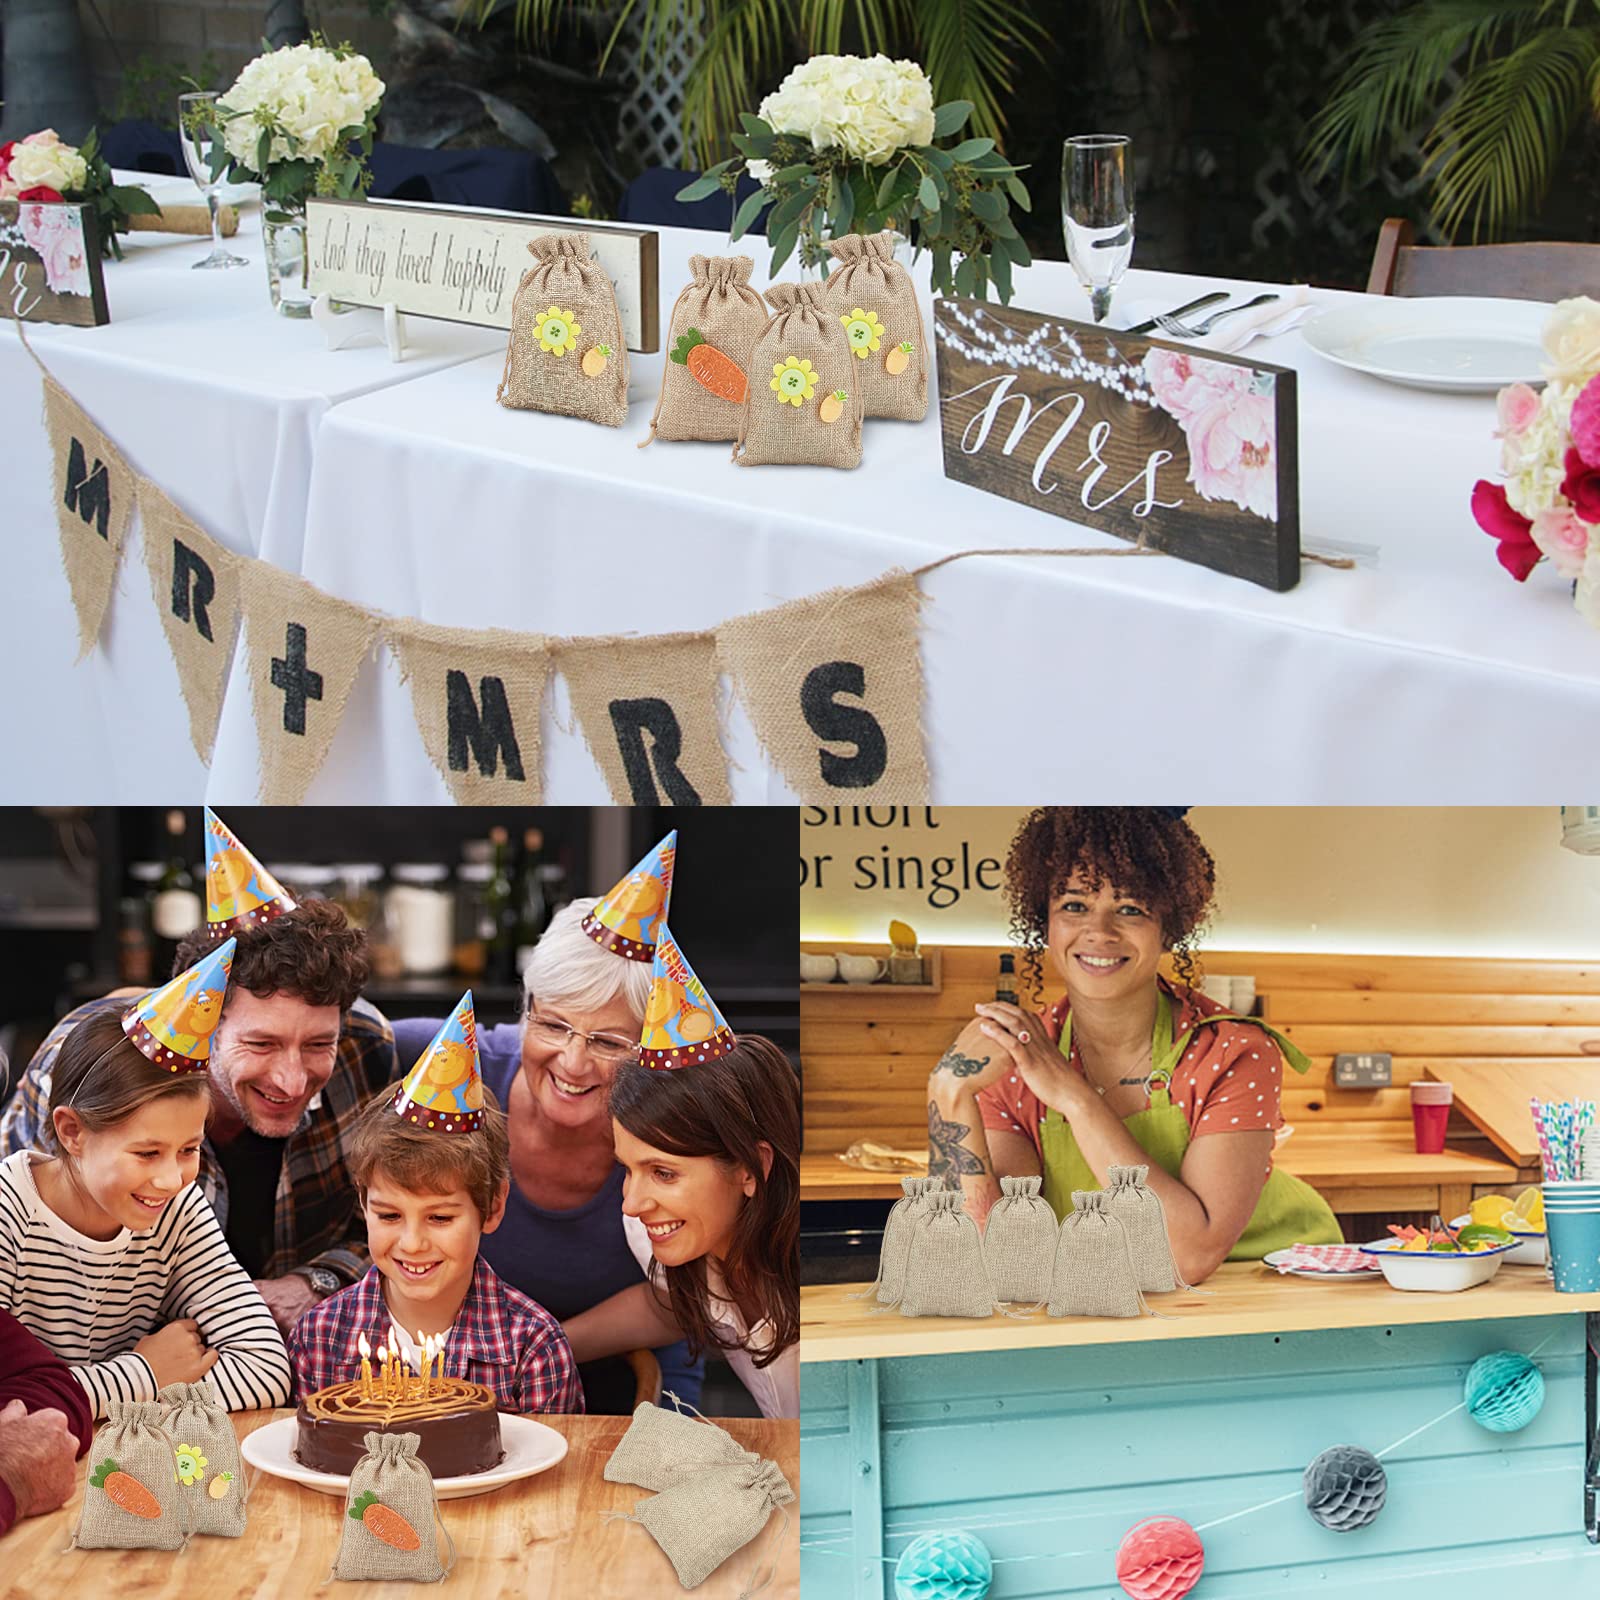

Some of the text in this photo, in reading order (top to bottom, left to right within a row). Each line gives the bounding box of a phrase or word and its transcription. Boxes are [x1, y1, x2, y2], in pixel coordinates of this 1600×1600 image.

[0, 249, 42, 318] r
[314, 218, 350, 270] And
[355, 224, 386, 298] they
[395, 228, 438, 285] lived
[441, 234, 506, 315] happily
[942, 374, 1183, 517] Mrs
[800, 842, 1000, 908] r single
